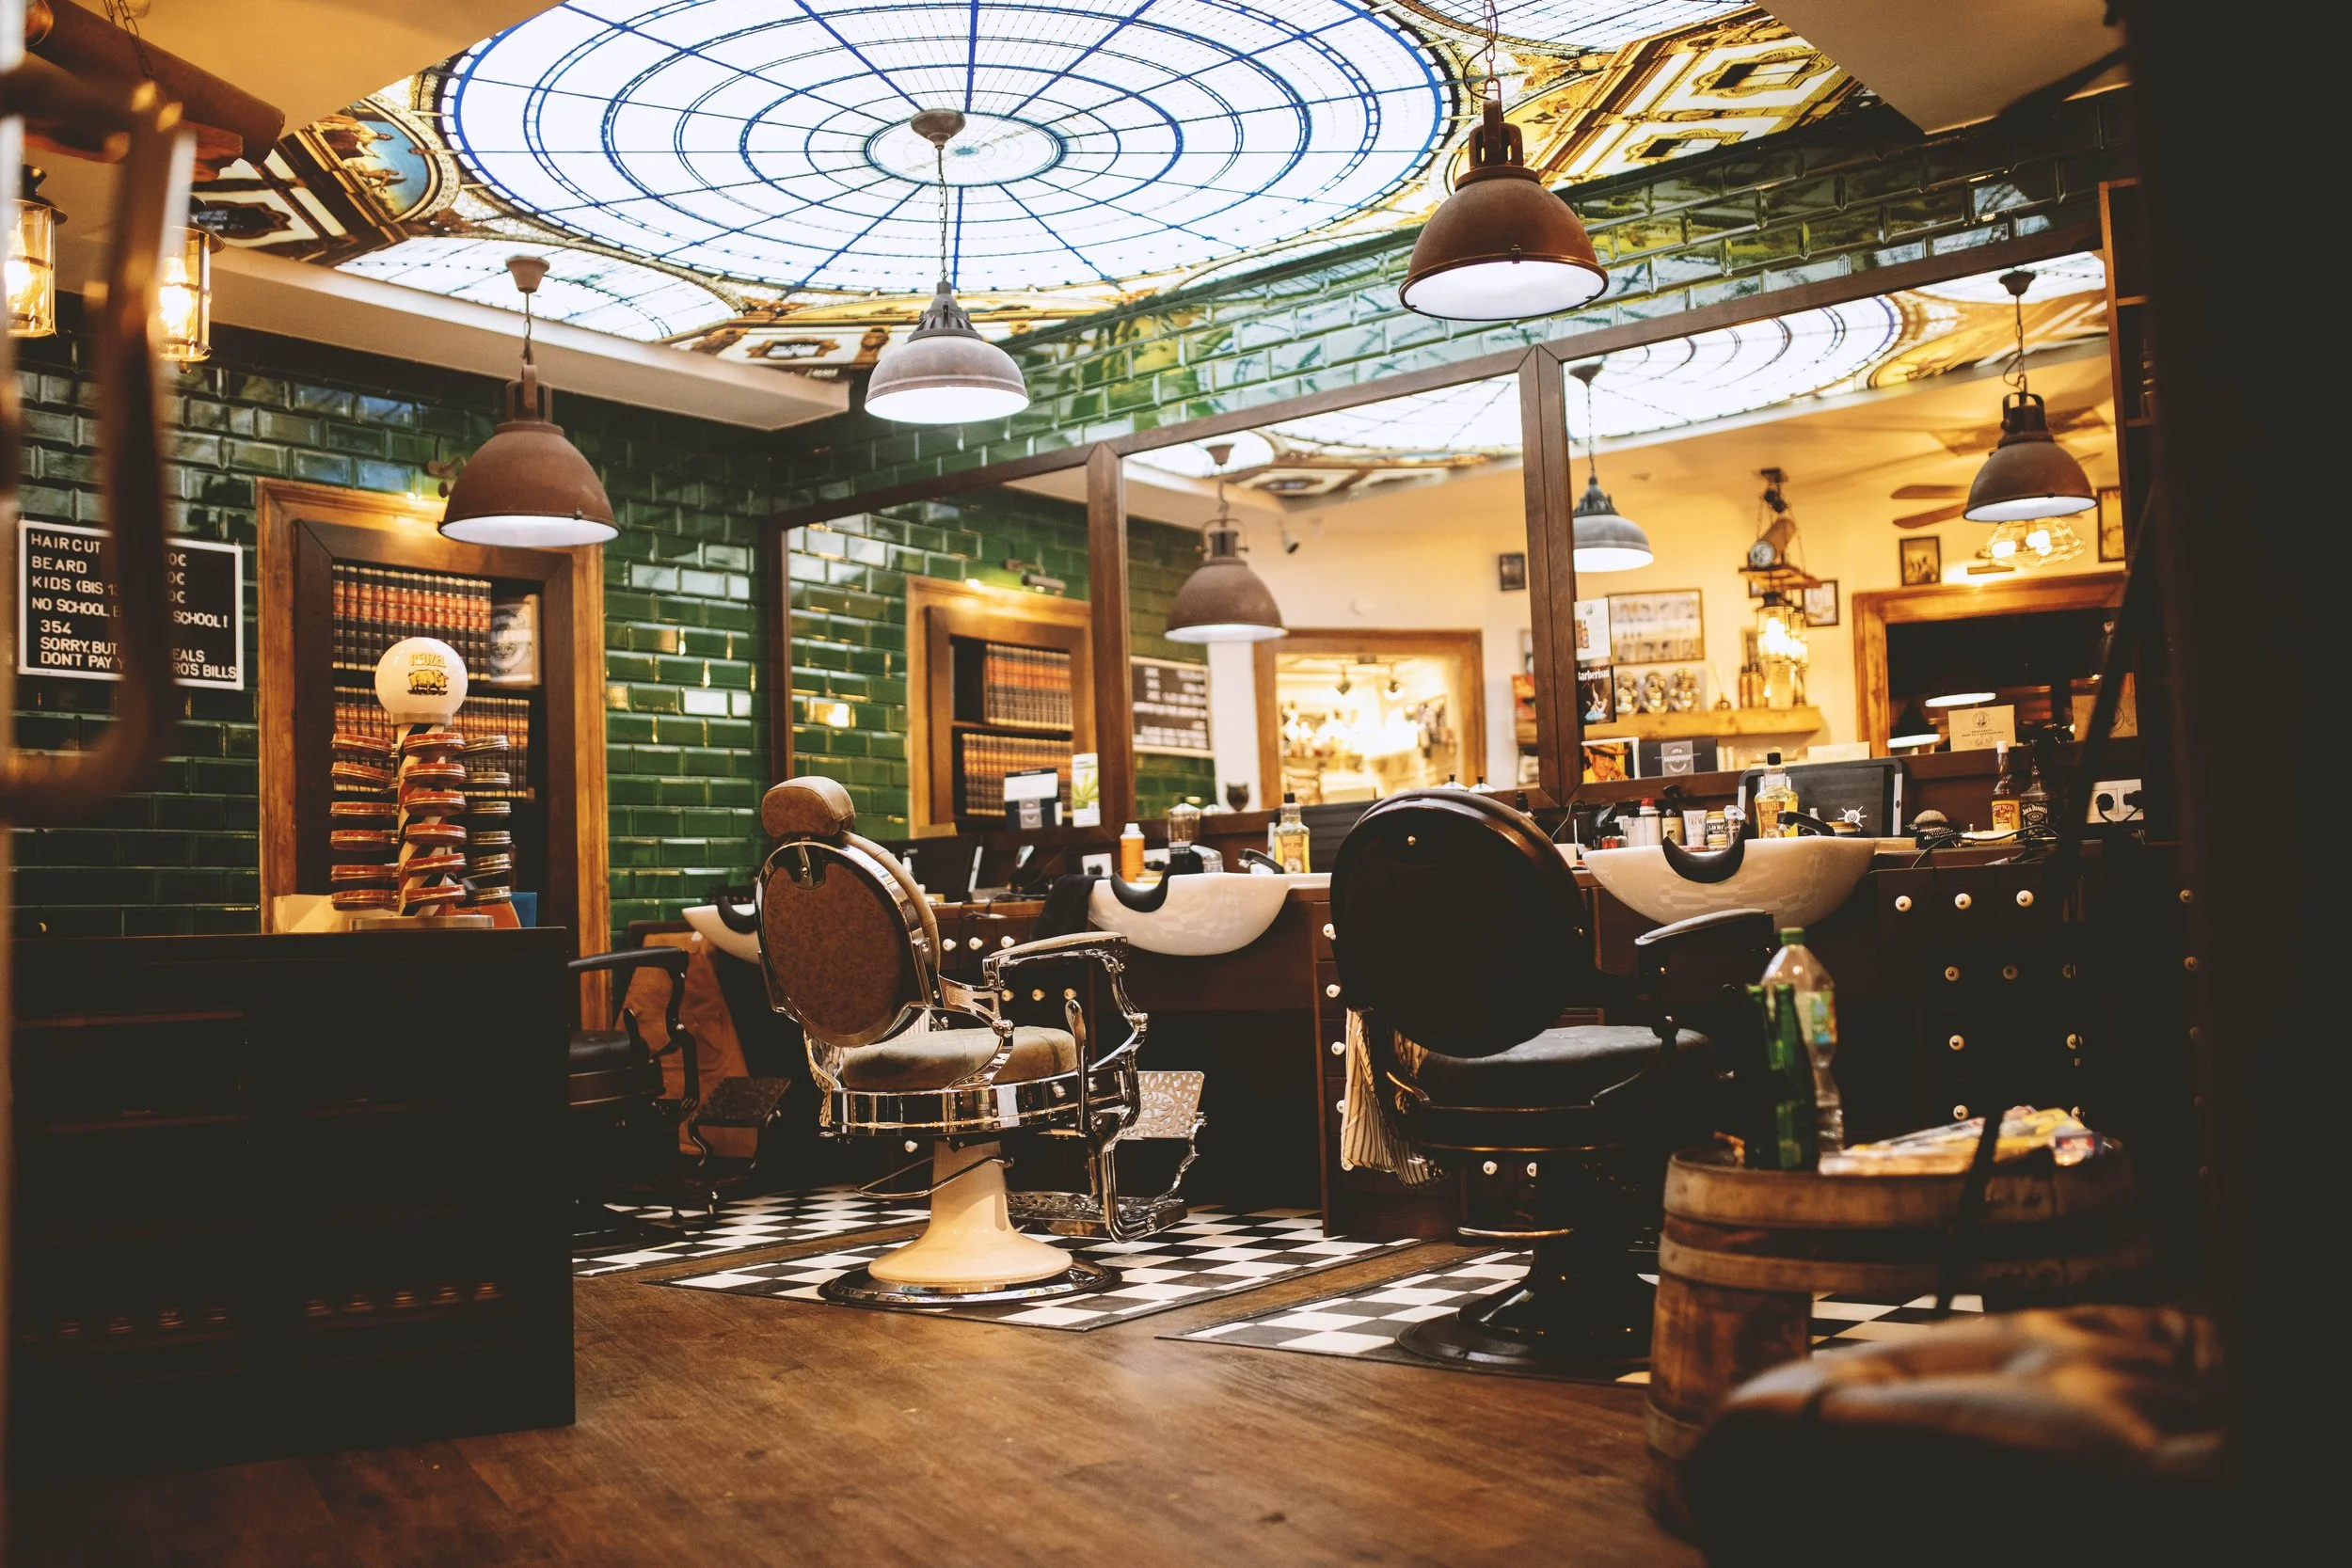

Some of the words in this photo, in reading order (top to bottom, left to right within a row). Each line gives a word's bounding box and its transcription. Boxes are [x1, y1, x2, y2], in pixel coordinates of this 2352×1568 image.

[30, 532, 101, 554] HAIRCUT
[31, 555, 87, 574] BEARD
[32, 575, 72, 592] KIDS
[75, 579, 104, 595] (BIS
[31, 596, 53, 611] NO
[40, 619, 72, 634] 354
[91, 641, 118, 655] BUT
[172, 647, 206, 663] EALS
[40, 650, 83, 667] DON'T
[87, 655, 112, 669] PAY
[202, 663, 237, 679] BILLS
